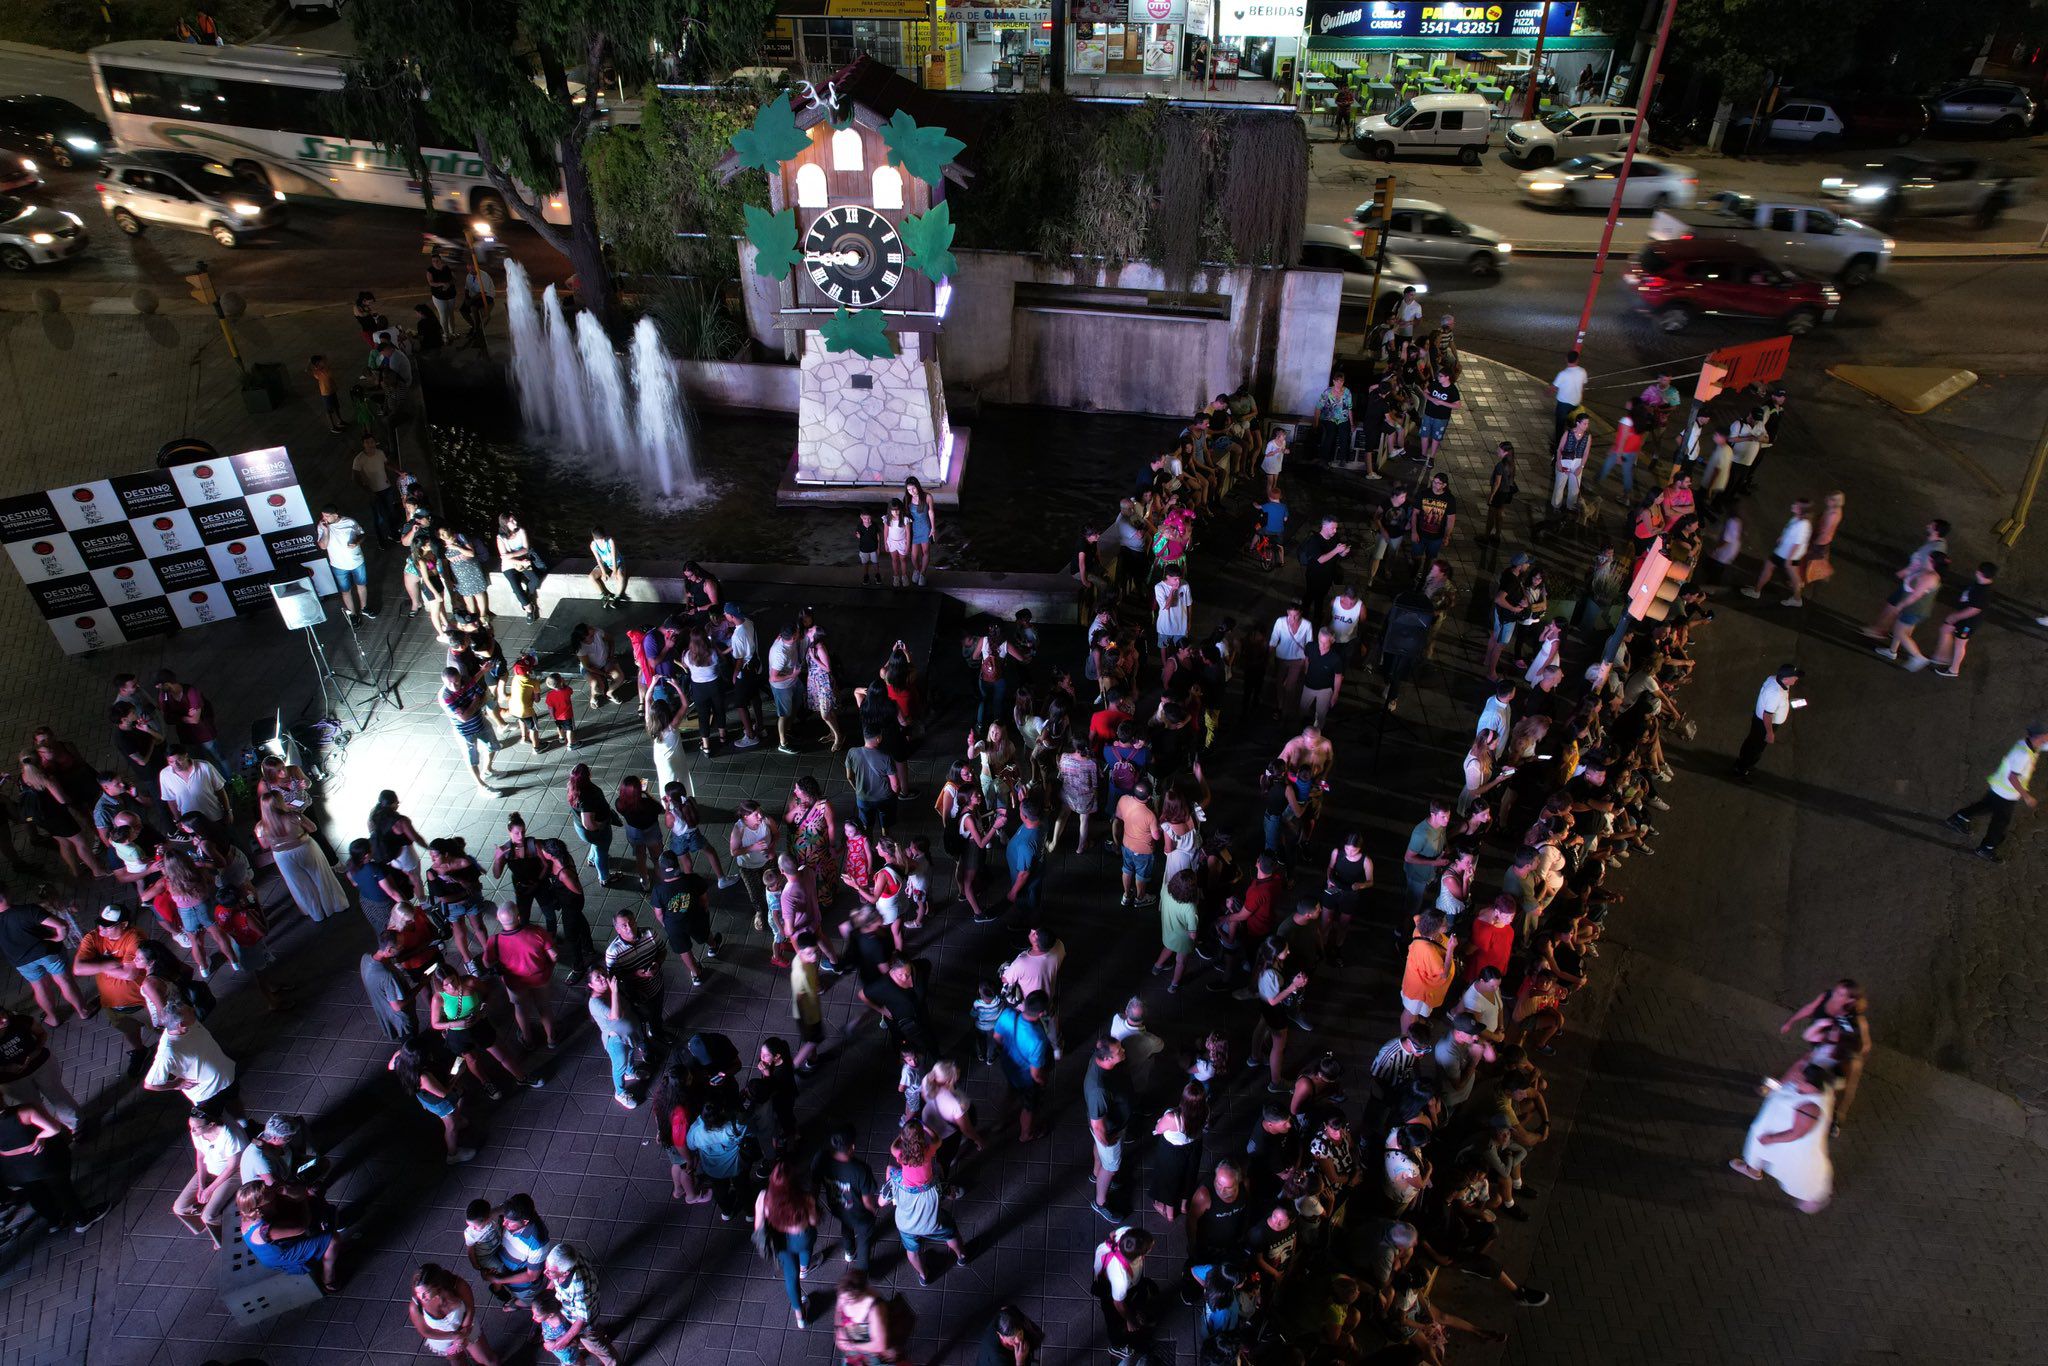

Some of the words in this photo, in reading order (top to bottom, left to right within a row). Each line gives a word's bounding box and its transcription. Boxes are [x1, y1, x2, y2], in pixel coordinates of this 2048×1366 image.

[967, 12, 979, 20] DE
[1020, 12, 1030, 20] EL
[1034, 12, 1048, 21] 117
[1249, 6, 1304, 17] BEBIDAS
[1320, 8, 1362, 33] Quilmes
[1420, 22, 1500, 34] 3541-432851
[1513, 18, 1534, 26] PIZZA
[845, 208, 858, 223] XII
[868, 215, 877, 228] I
[241, 461, 285, 476] DESTINO
[123, 484, 170, 498] DESTINO
[0, 507, 48, 522] DESTINO
[199, 508, 243, 524] DESTINO
[82, 532, 128, 549] DESTINO
[272, 534, 313, 549] DESTINO
[160, 558, 205, 574] DESTINO
[43, 584, 90, 599] DESTINO
[121, 606, 166, 623] DESTINO
[1334, 615, 1352, 623] FILA
